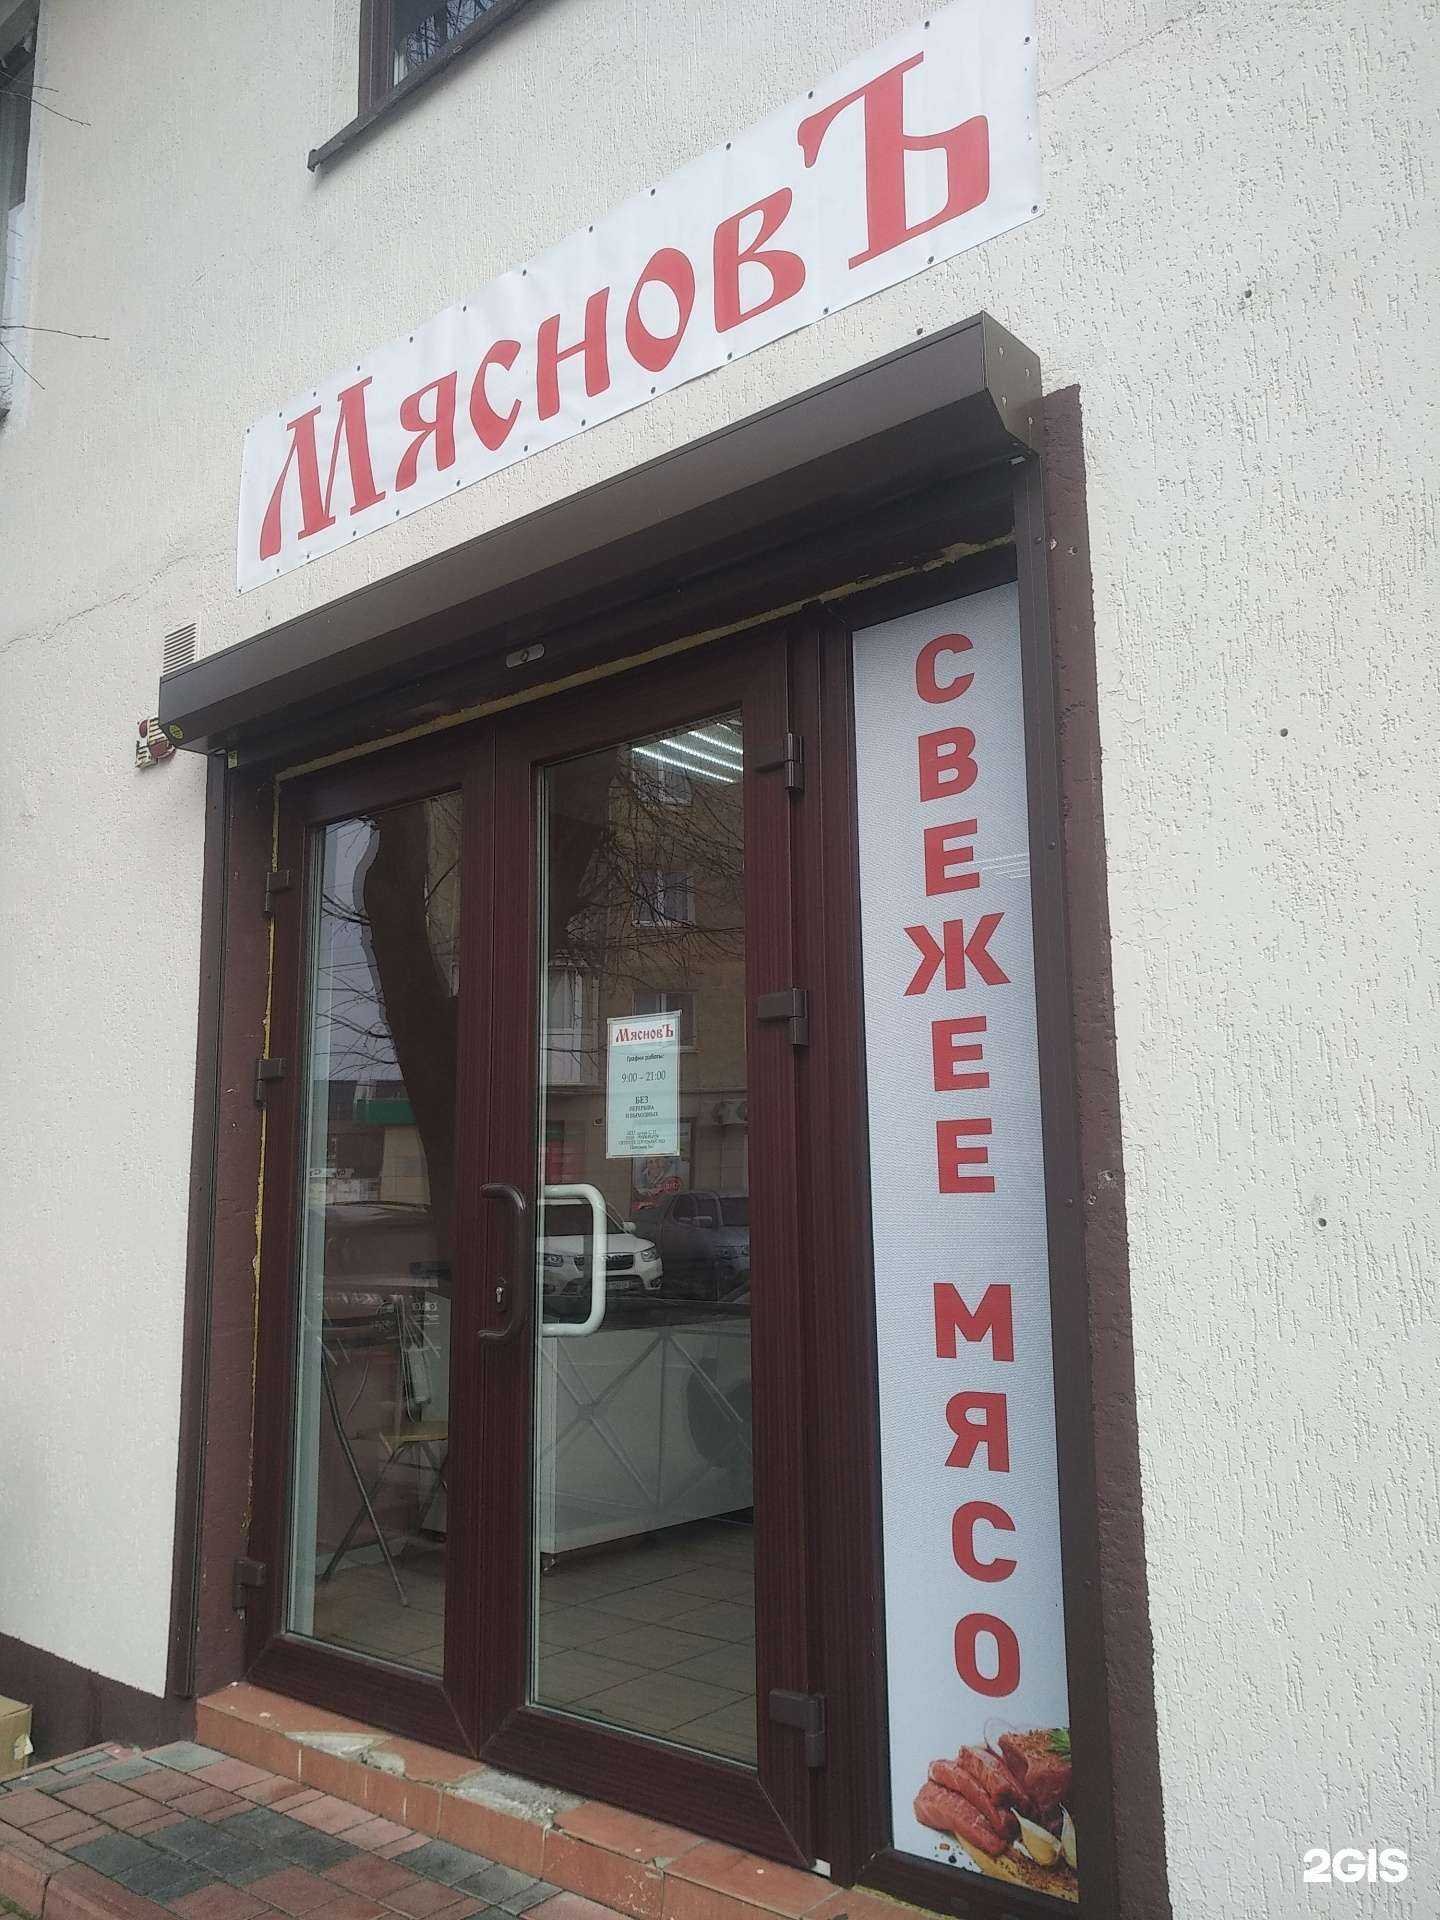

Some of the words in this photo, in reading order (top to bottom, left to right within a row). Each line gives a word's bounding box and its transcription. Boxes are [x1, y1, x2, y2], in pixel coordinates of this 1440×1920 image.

[259, 51, 990, 562] МясновЪ
[635, 1095, 649, 1104] БЕЗ
[645, 1070, 666, 1082] 21:00
[903, 632, 1011, 1195] СВЕЖЕЕ
[933, 1282, 1020, 1698] МЯСО
